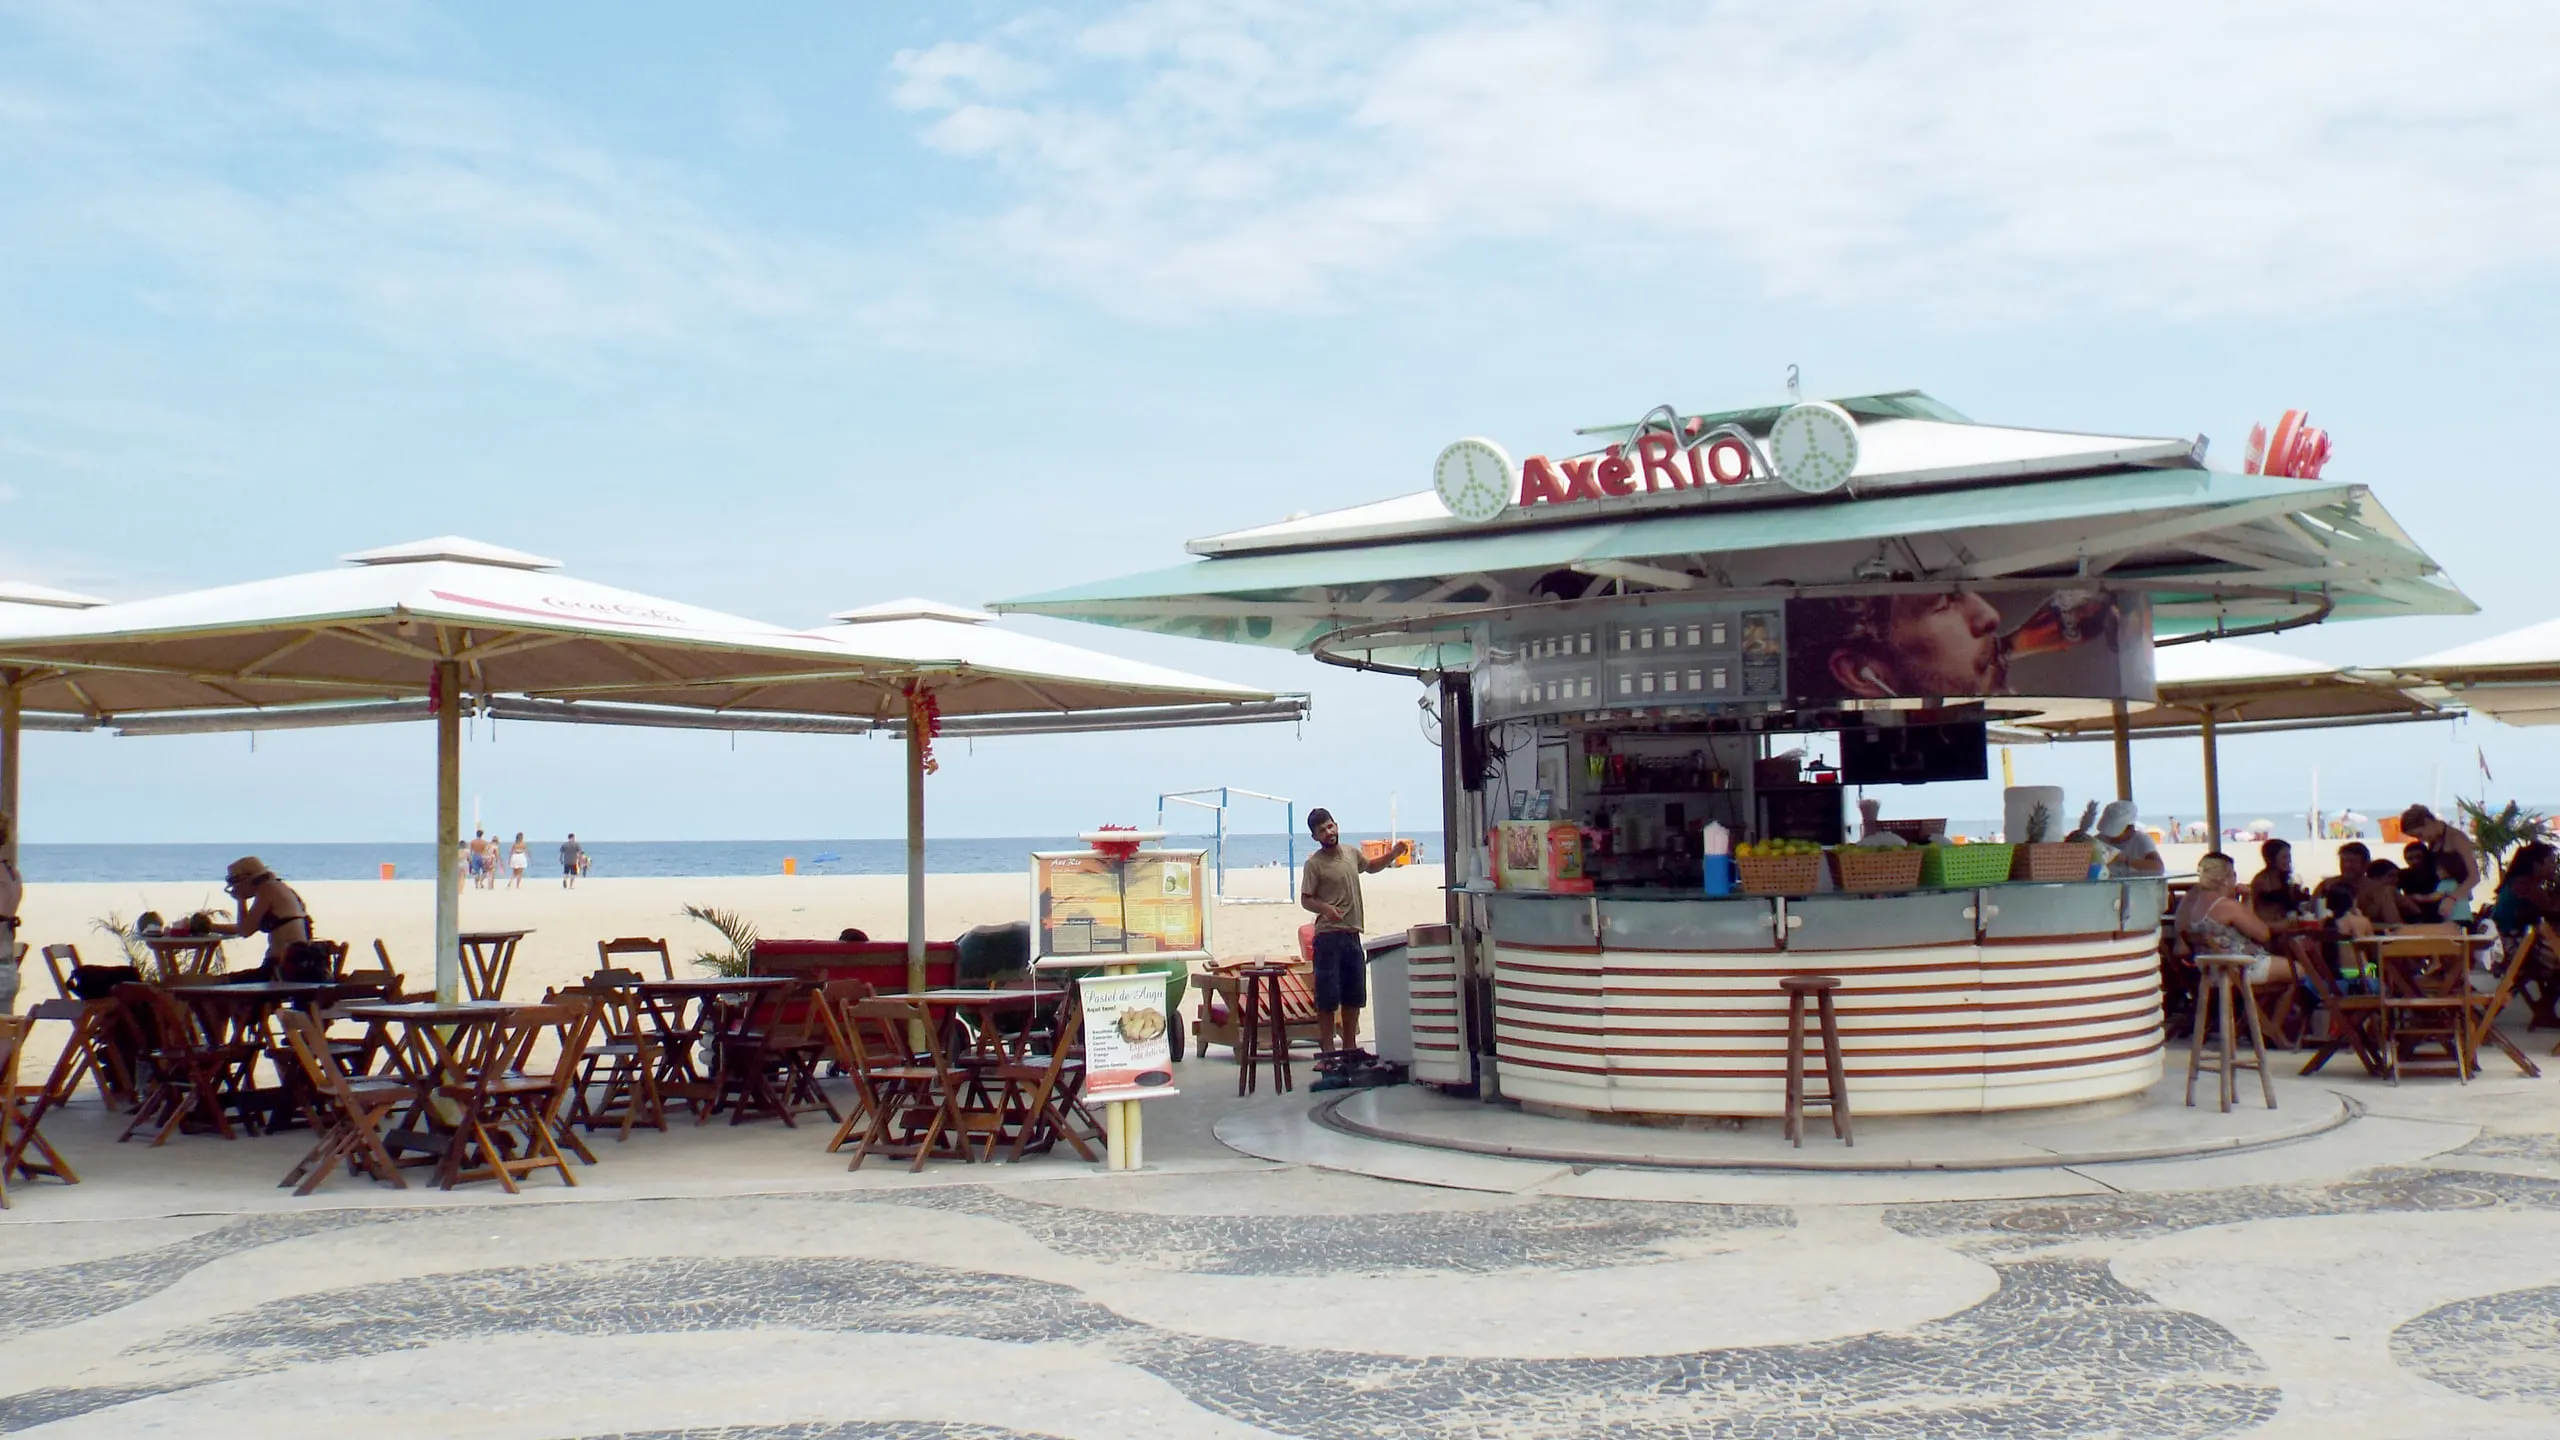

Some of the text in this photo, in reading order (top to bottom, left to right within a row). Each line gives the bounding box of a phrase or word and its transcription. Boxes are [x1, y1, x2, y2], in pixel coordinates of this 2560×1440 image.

[1084, 986, 1163, 1003] Pastel de Angu
